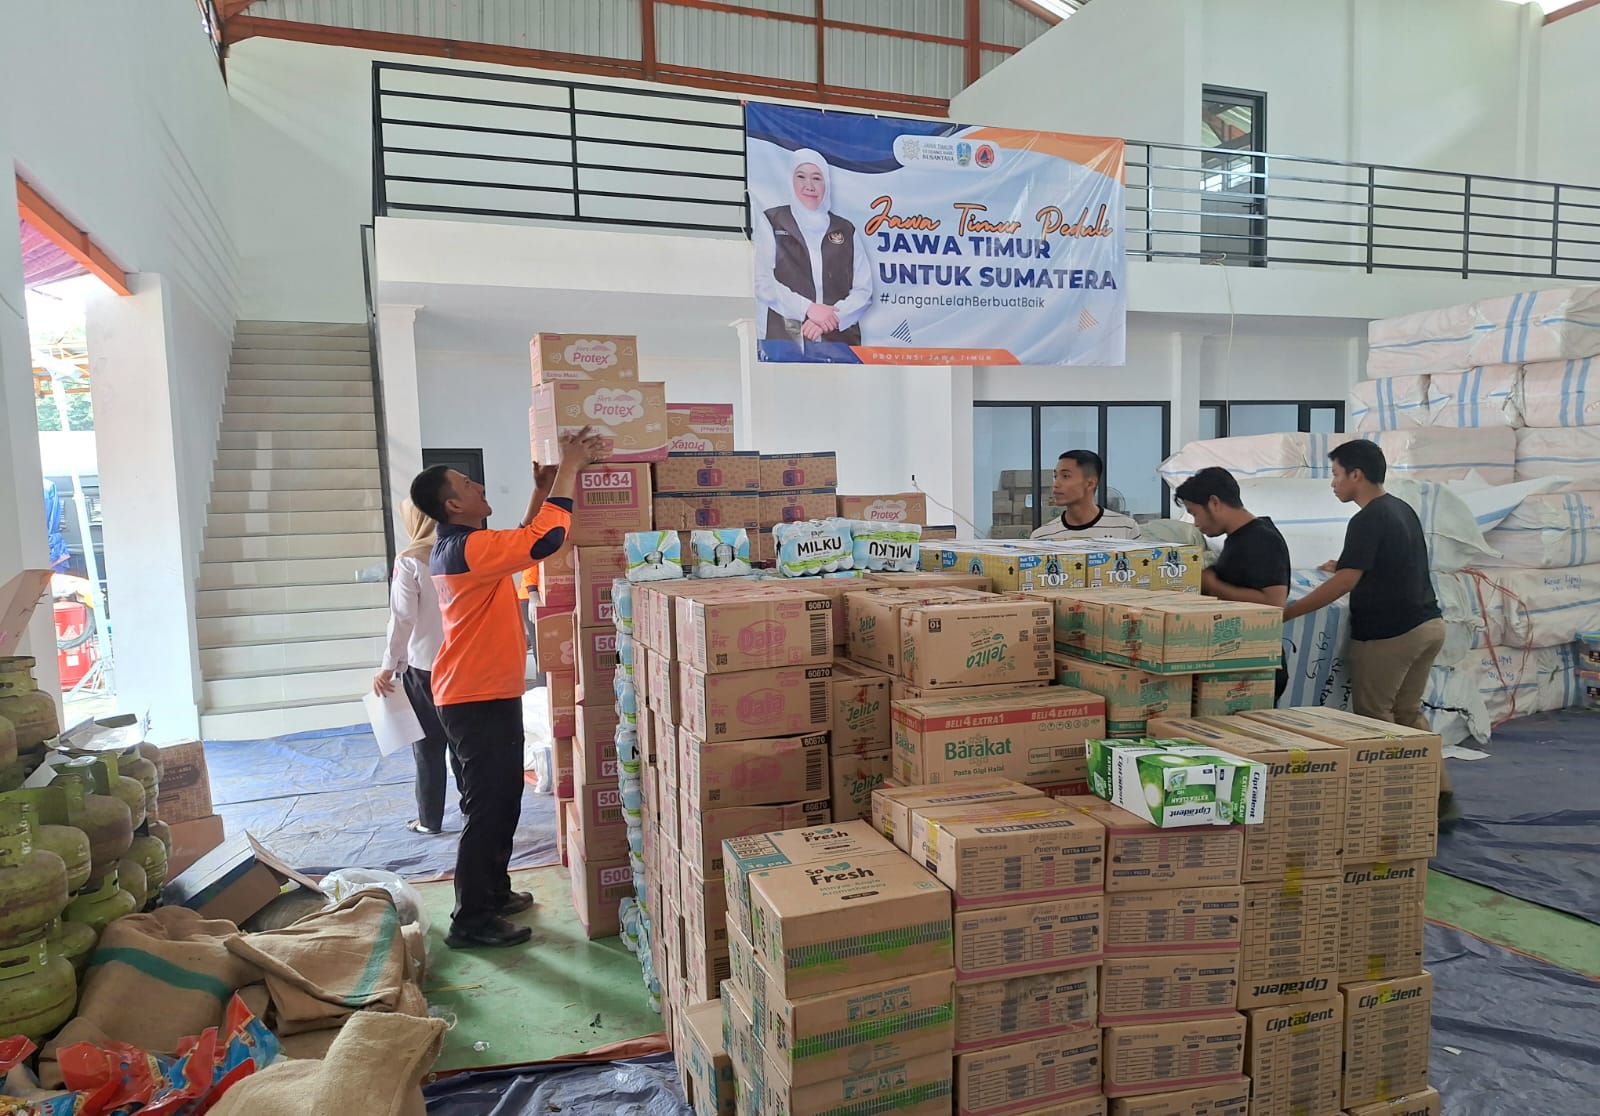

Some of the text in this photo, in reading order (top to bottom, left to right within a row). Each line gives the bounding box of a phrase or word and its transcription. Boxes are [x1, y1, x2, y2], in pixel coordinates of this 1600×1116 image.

[864, 195, 1114, 241] Jawa Timur Peduli
[877, 232, 1051, 260] JAWA TIMUR
[878, 262, 1118, 291] UNTUK SUMATERA
[879, 292, 1045, 309] #JanganLelahBerbuatBaik
[572, 352, 610, 366] Protex
[872, 352, 924, 361] PROVINSI
[593, 403, 635, 418] Protex
[671, 440, 706, 451] Protex
[584, 473, 630, 488] 50034
[870, 510, 901, 521] Protex
[797, 536, 842, 557] MILKU
[869, 541, 912, 559] MILKU
[1106, 570, 1136, 583] TOP
[1157, 564, 1187, 578] TOP
[1037, 573, 1069, 587] TOP
[966, 643, 1008, 669] Jelita
[846, 701, 880, 722] Jelita
[1032, 711, 1048, 721] BELI
[1049, 708, 1057, 719] 4
[1057, 708, 1084, 719] EXTRA
[945, 719, 963, 729] BELI
[963, 716, 971, 727] 4
[972, 716, 999, 727] EXTRA
[1356, 747, 1429, 764] Ciptadent
[953, 769, 972, 777] Pasta
[973, 767, 986, 777] Gigi
[850, 773, 883, 796] Jelita
[1249, 771, 1260, 818] Ciptadent
[1169, 806, 1211, 818] Ciptadent
[804, 830, 849, 843] Fresh
[981, 825, 1018, 834] EXTRA
[804, 868, 824, 876] So
[810, 867, 874, 885] Fresh
[1252, 977, 1329, 997] Ciptadent
[1266, 1008, 1334, 1033] Ciptadent
